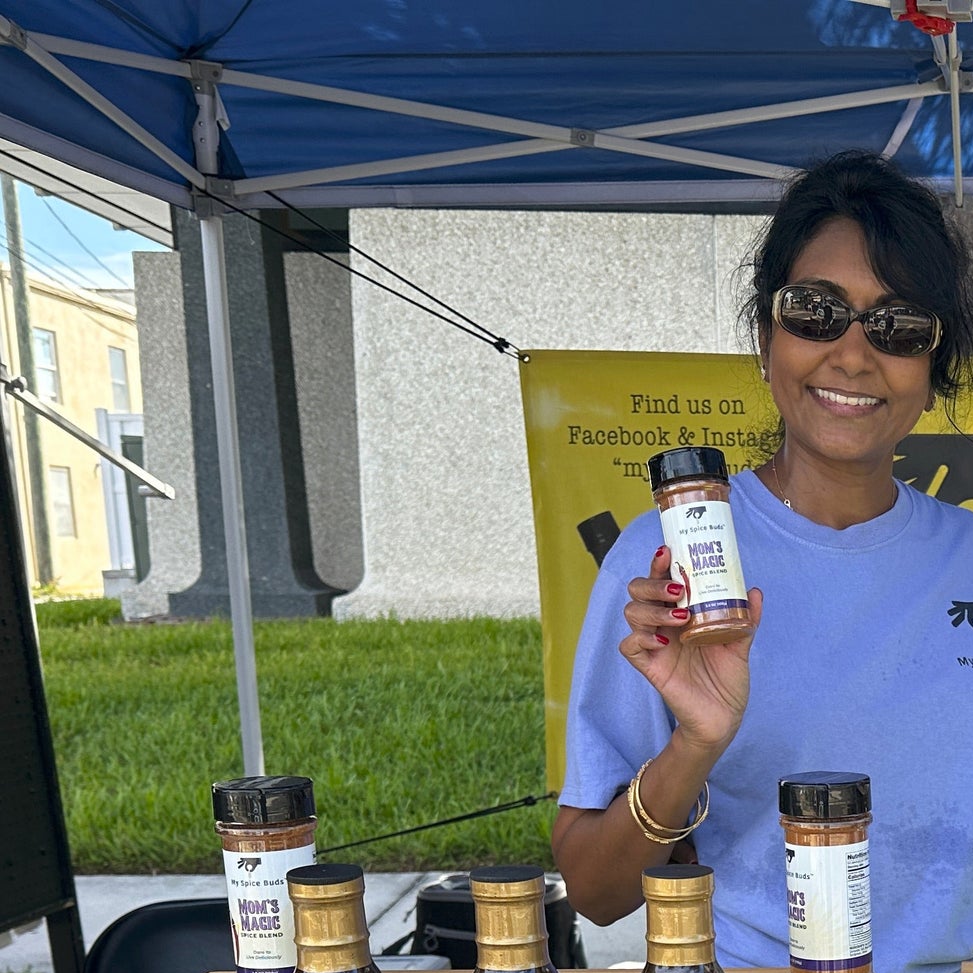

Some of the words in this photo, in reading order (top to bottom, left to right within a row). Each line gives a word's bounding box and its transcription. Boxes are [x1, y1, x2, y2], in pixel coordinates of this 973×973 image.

[631, 394, 681, 414] Find
[687, 399, 712, 415] us
[719, 399, 746, 415] on
[568, 426, 671, 446] Facebook
[678, 426, 695, 446] &
[702, 428, 772, 451] Instag
[690, 525, 707, 533] Spice
[688, 541, 723, 558] MOM'S
[690, 555, 726, 572] MAGIC
[240, 879, 261, 888] Spice
[237, 898, 280, 915] MOM'S
[240, 915, 281, 932] MAGIC
